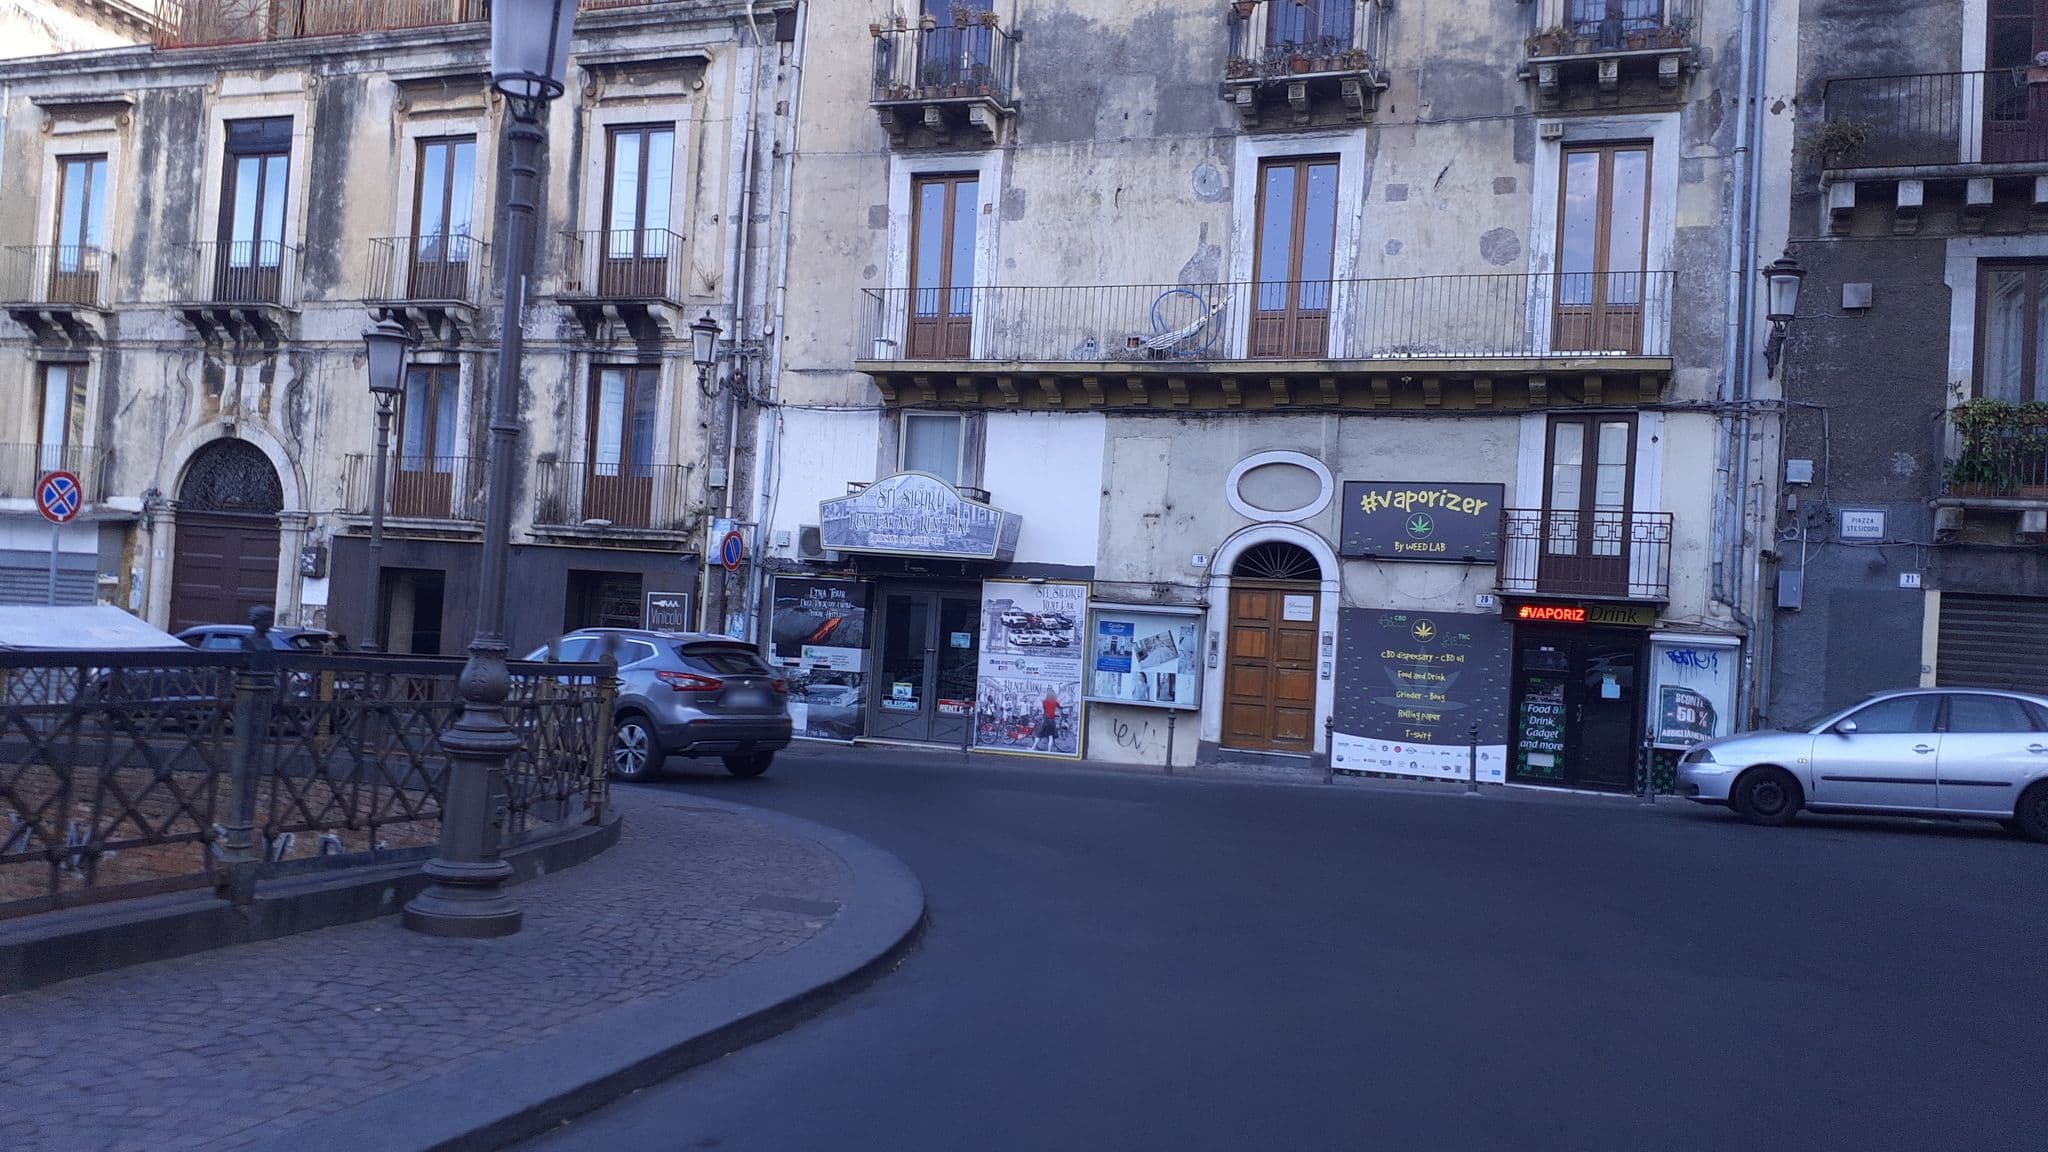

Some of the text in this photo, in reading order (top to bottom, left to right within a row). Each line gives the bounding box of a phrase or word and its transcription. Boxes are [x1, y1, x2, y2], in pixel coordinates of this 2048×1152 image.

[1406, 543, 1428, 551] WEED
[1429, 542, 1446, 552] LAB
[1519, 606, 1585, 621] #VAPORIZ
[1589, 606, 1638, 623] Drink
[1413, 671, 1426, 680] and
[1427, 672, 1446, 682] Drink
[1396, 691, 1421, 700] Grinder
[1430, 692, 1445, 703] Bong
[1527, 704, 1551, 714] Food
[1398, 709, 1441, 722] Rolling paper
[1529, 716, 1554, 726] Drink
[1405, 729, 1432, 741] T-shirt
[1526, 727, 1559, 739] Gadget
[1520, 740, 1563, 750] and more
